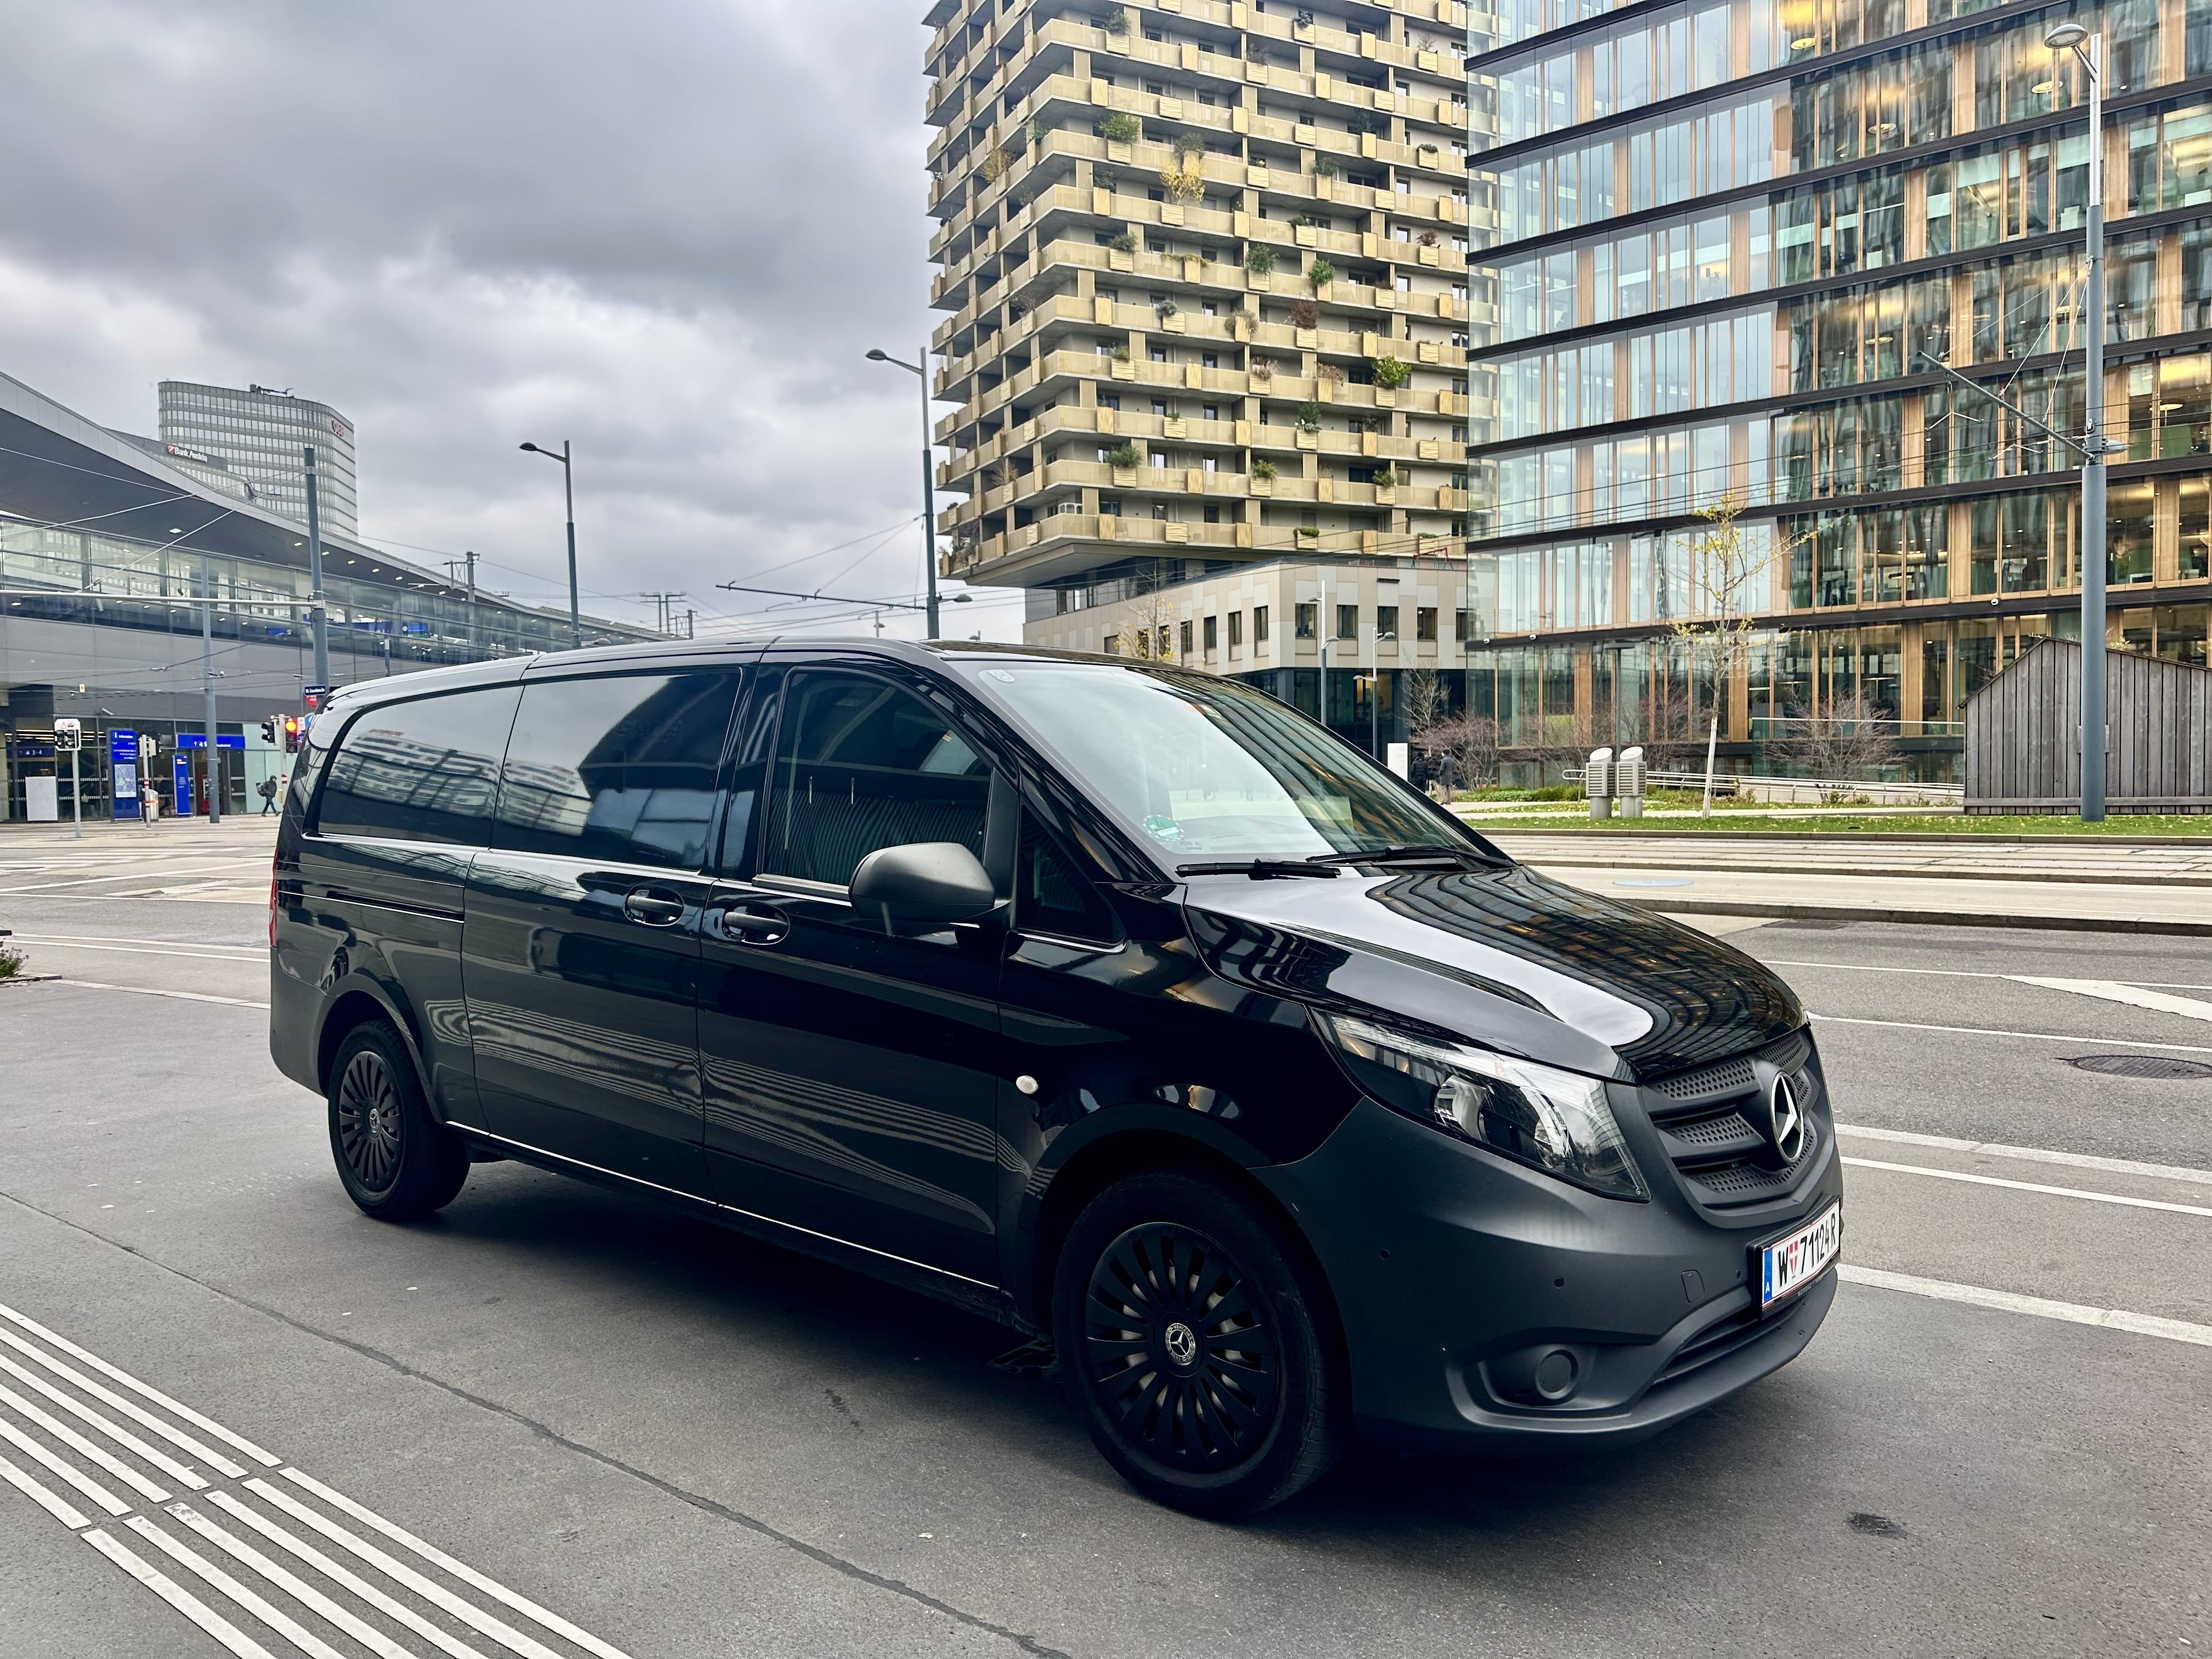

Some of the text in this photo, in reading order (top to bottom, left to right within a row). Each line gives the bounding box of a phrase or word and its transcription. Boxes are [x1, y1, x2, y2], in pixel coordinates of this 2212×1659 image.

[174, 447, 208, 462] Bank Austria
[1778, 1246, 1788, 1288] W
[1765, 1282, 1770, 1294] A
